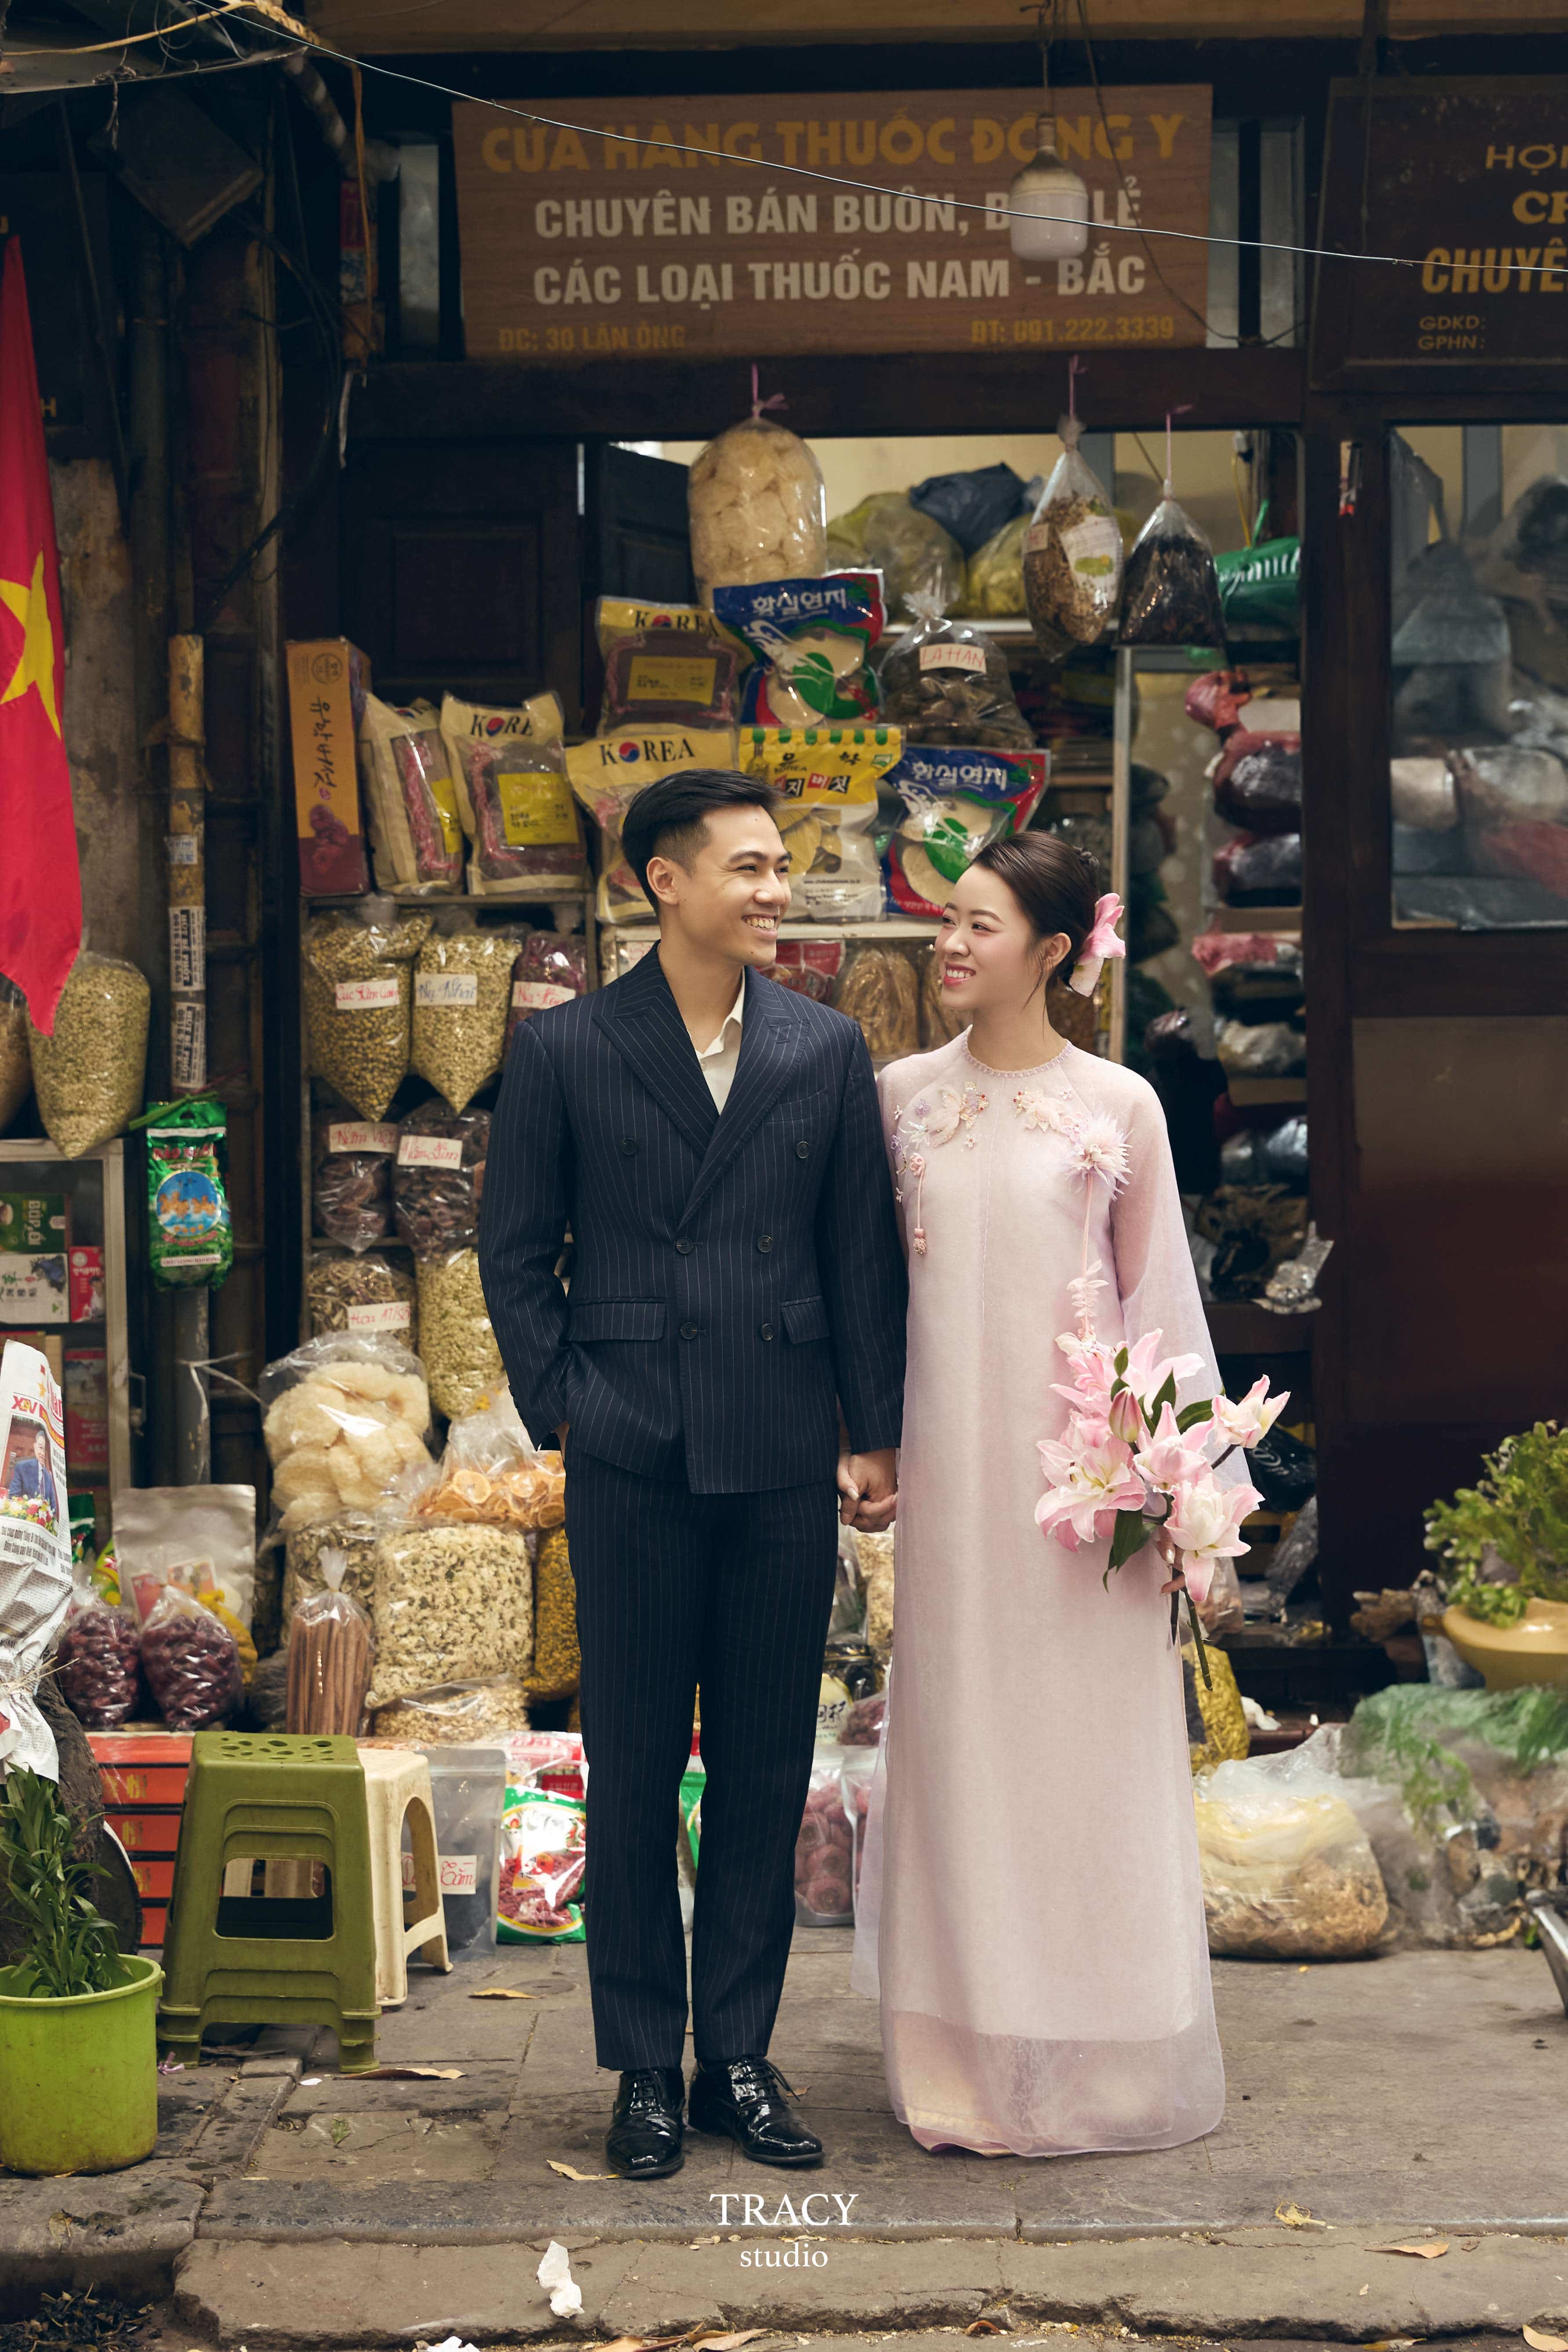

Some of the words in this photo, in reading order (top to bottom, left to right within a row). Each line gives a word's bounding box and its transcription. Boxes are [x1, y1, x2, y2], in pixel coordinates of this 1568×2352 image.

[604, 118, 763, 171] HÀNG
[774, 106, 956, 166] THUỐC
[1149, 114, 1186, 159] Y
[535, 189, 710, 238] CHUYÊN
[726, 187, 817, 234] BÁN
[833, 185, 967, 236] BUÔN,
[1093, 174, 1142, 227] LẺ
[534, 258, 621, 305] CÁC
[637, 263, 733, 309] LOẠI
[748, 247, 891, 300] THUỐC
[907, 260, 1009, 299] NAM
[1058, 242, 1146, 295] BẮC
[1421, 237, 1568, 294] CHUYÊ
[545, 327, 574, 349] 30
[1013, 316, 1175, 343] 091.222.3339
[470, 713, 534, 738] KORE
[600, 738, 696, 766] KOREA
